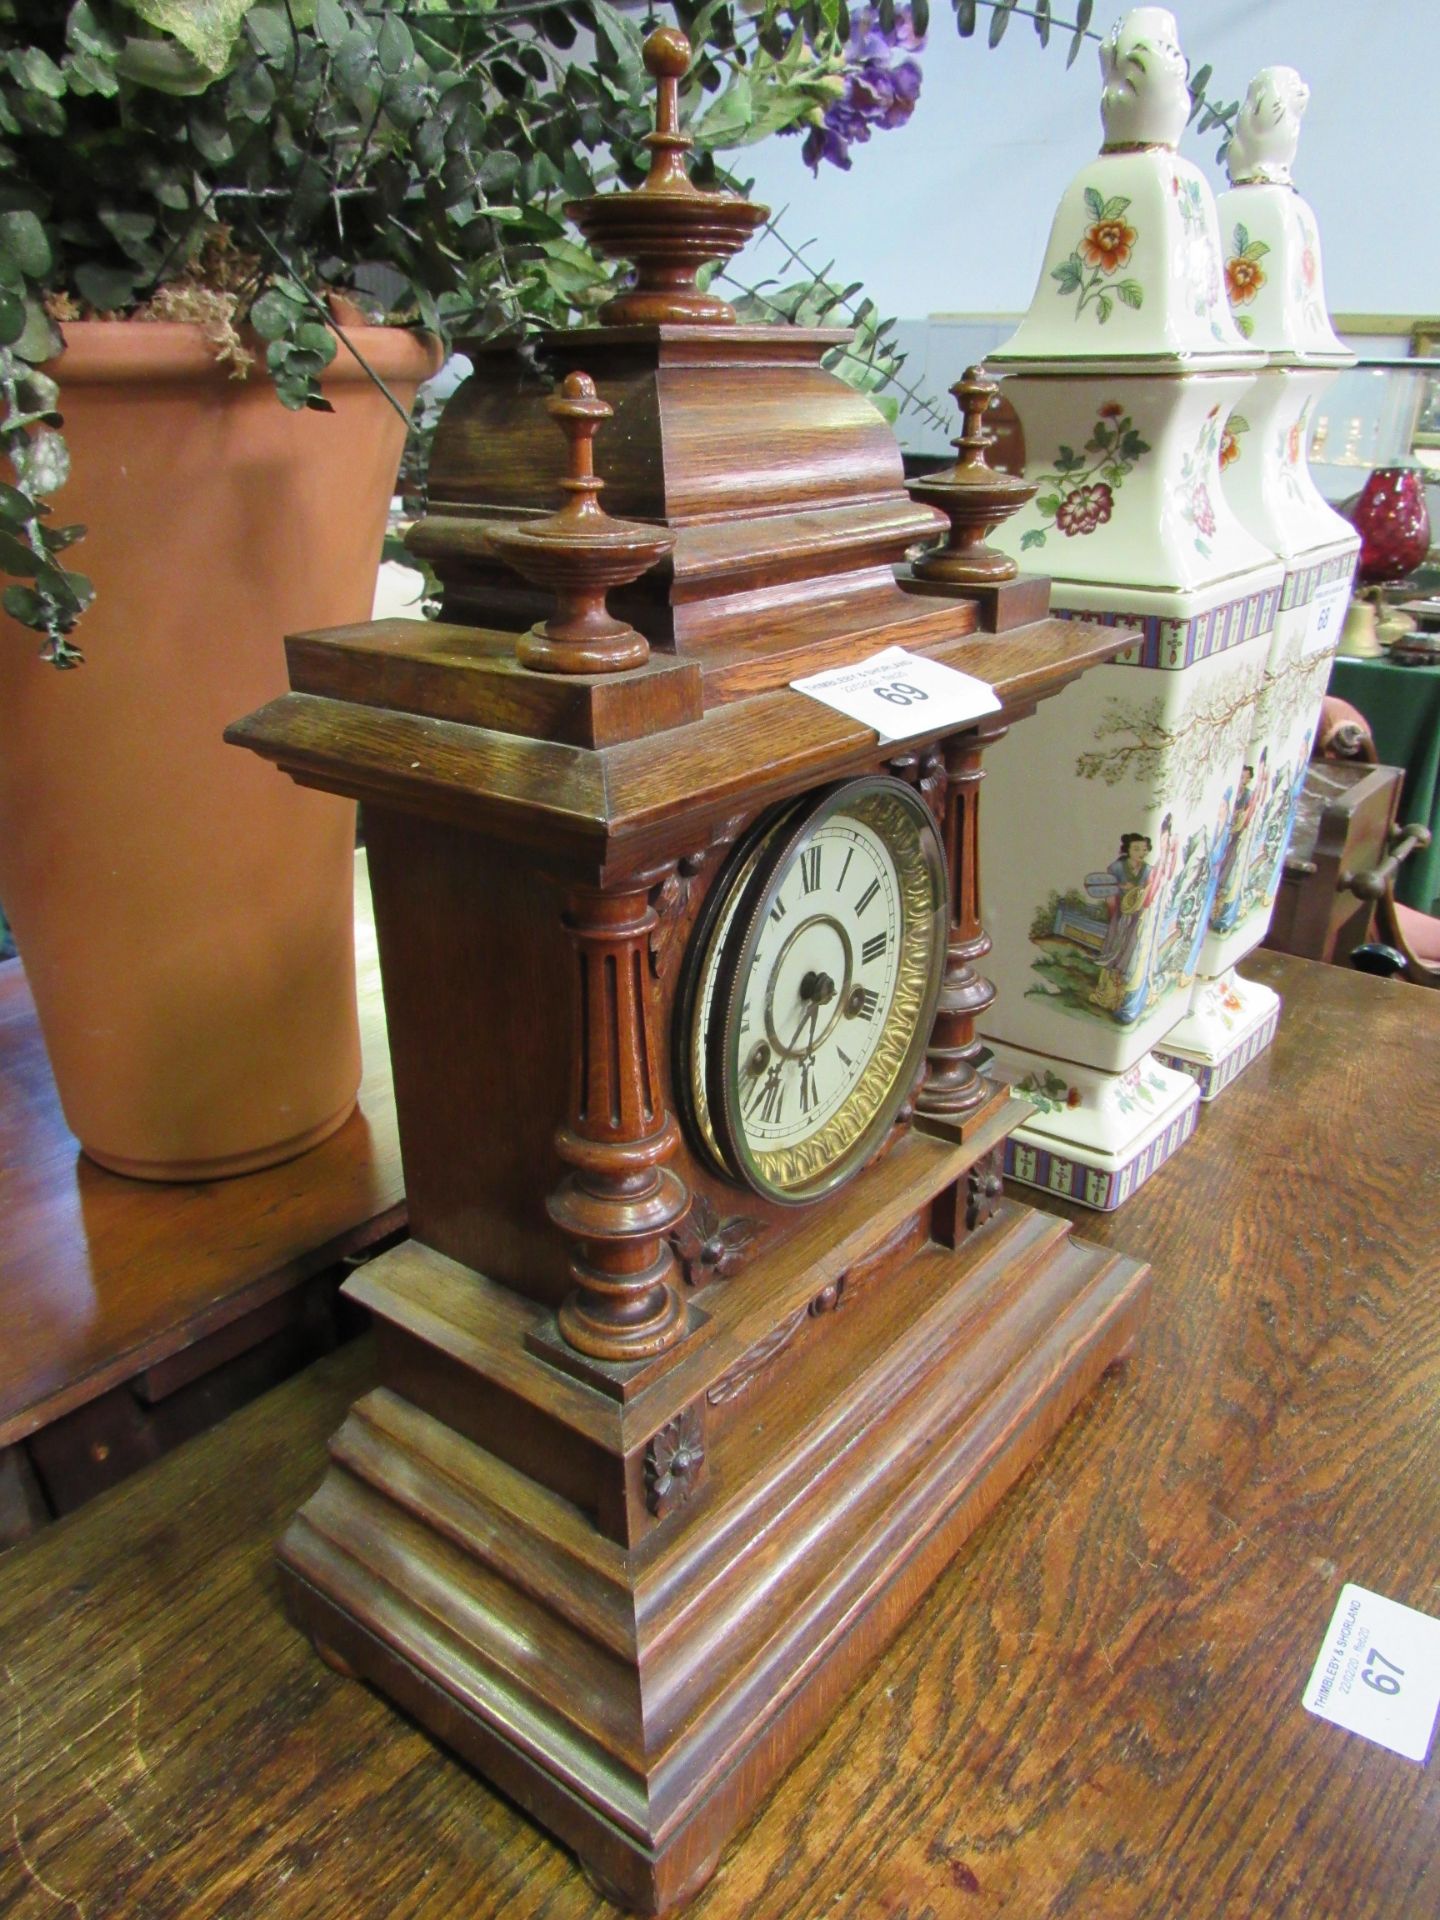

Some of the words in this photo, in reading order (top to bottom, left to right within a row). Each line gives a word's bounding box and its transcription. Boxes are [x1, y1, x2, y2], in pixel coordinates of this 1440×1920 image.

[873, 682, 929, 706] 69
[854, 876, 881, 919] II
[862, 930, 887, 966] III
[1336, 1599, 1361, 1648] SHORLAND
[1333, 1648, 1345, 1657] &
[1360, 1647, 1406, 1696] 67
[1314, 1655, 1341, 1709] THIMBLEBY
